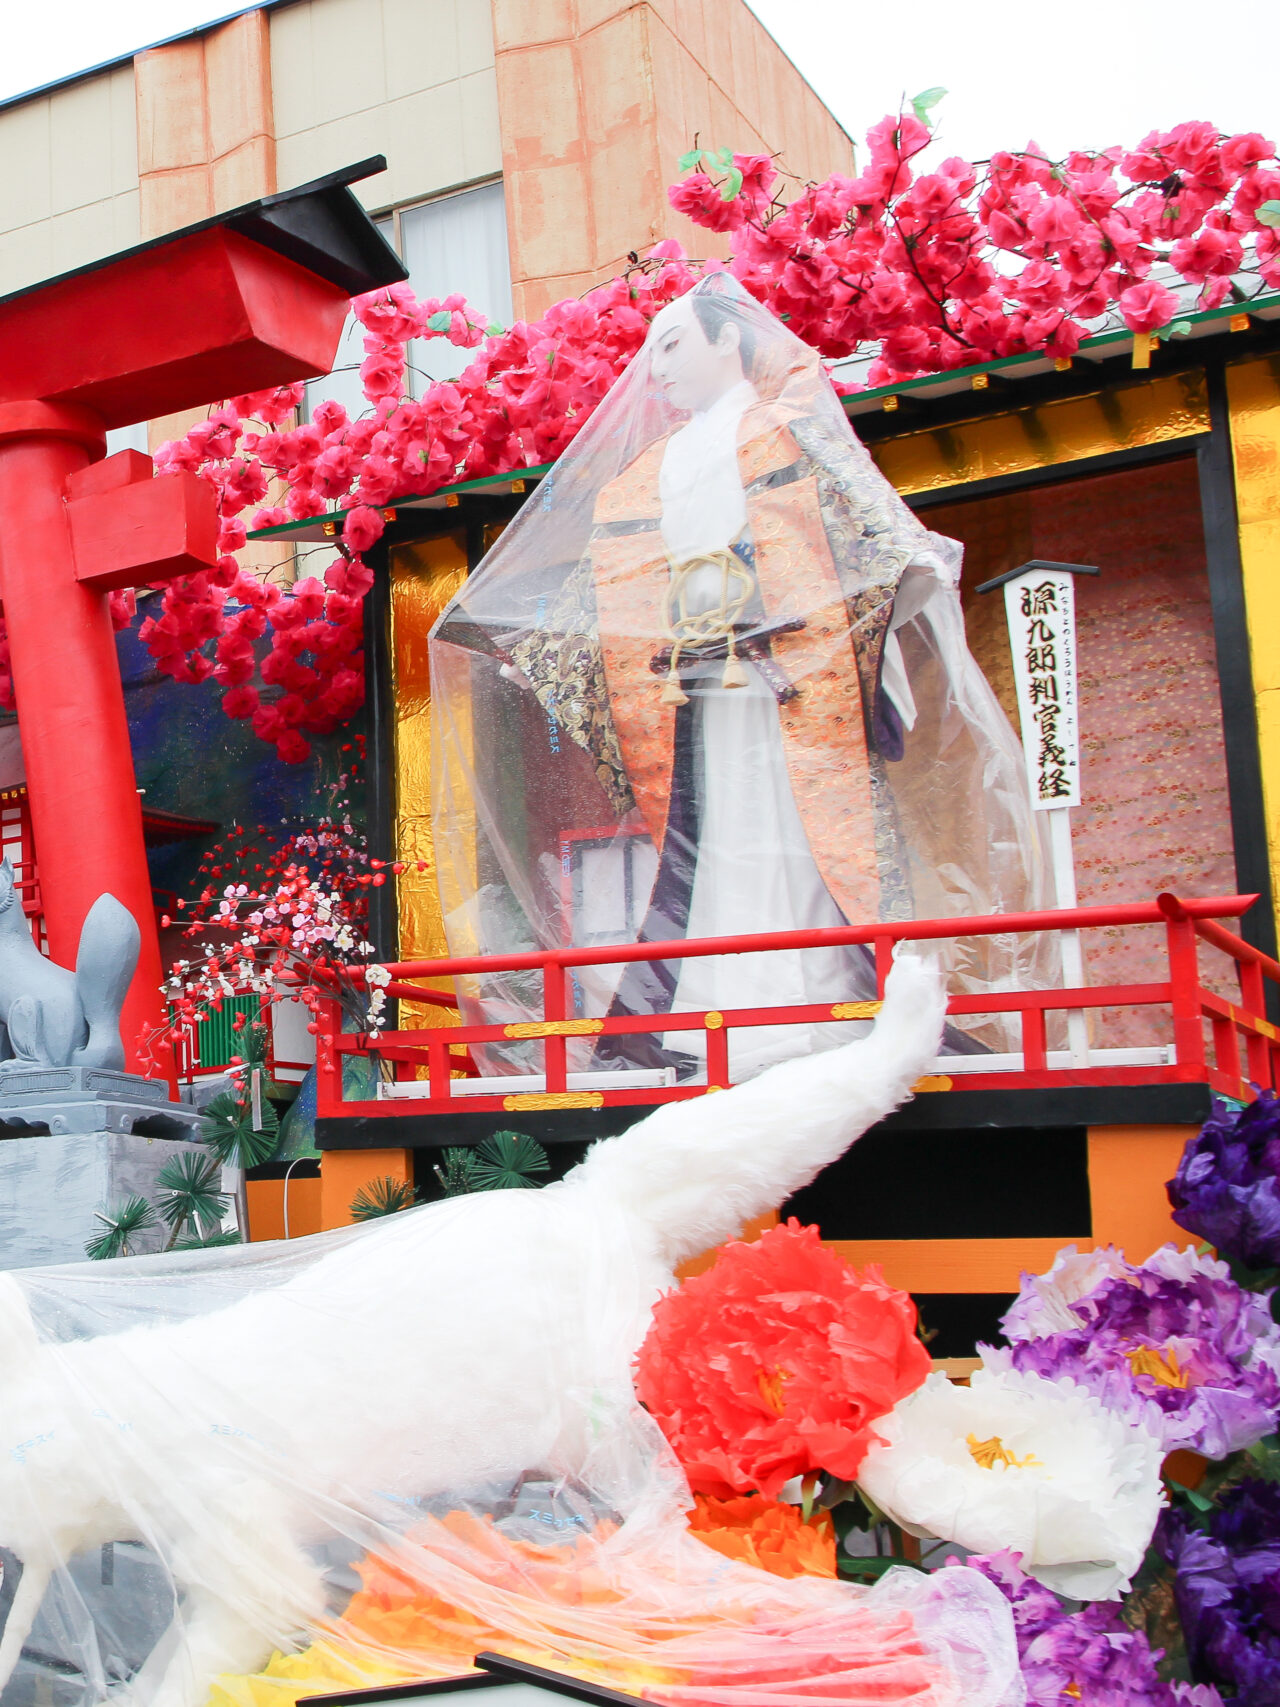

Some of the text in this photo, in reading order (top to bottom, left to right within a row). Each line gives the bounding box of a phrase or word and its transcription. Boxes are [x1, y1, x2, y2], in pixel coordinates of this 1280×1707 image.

[1020, 580, 1071, 800] 源九郎判官義経
